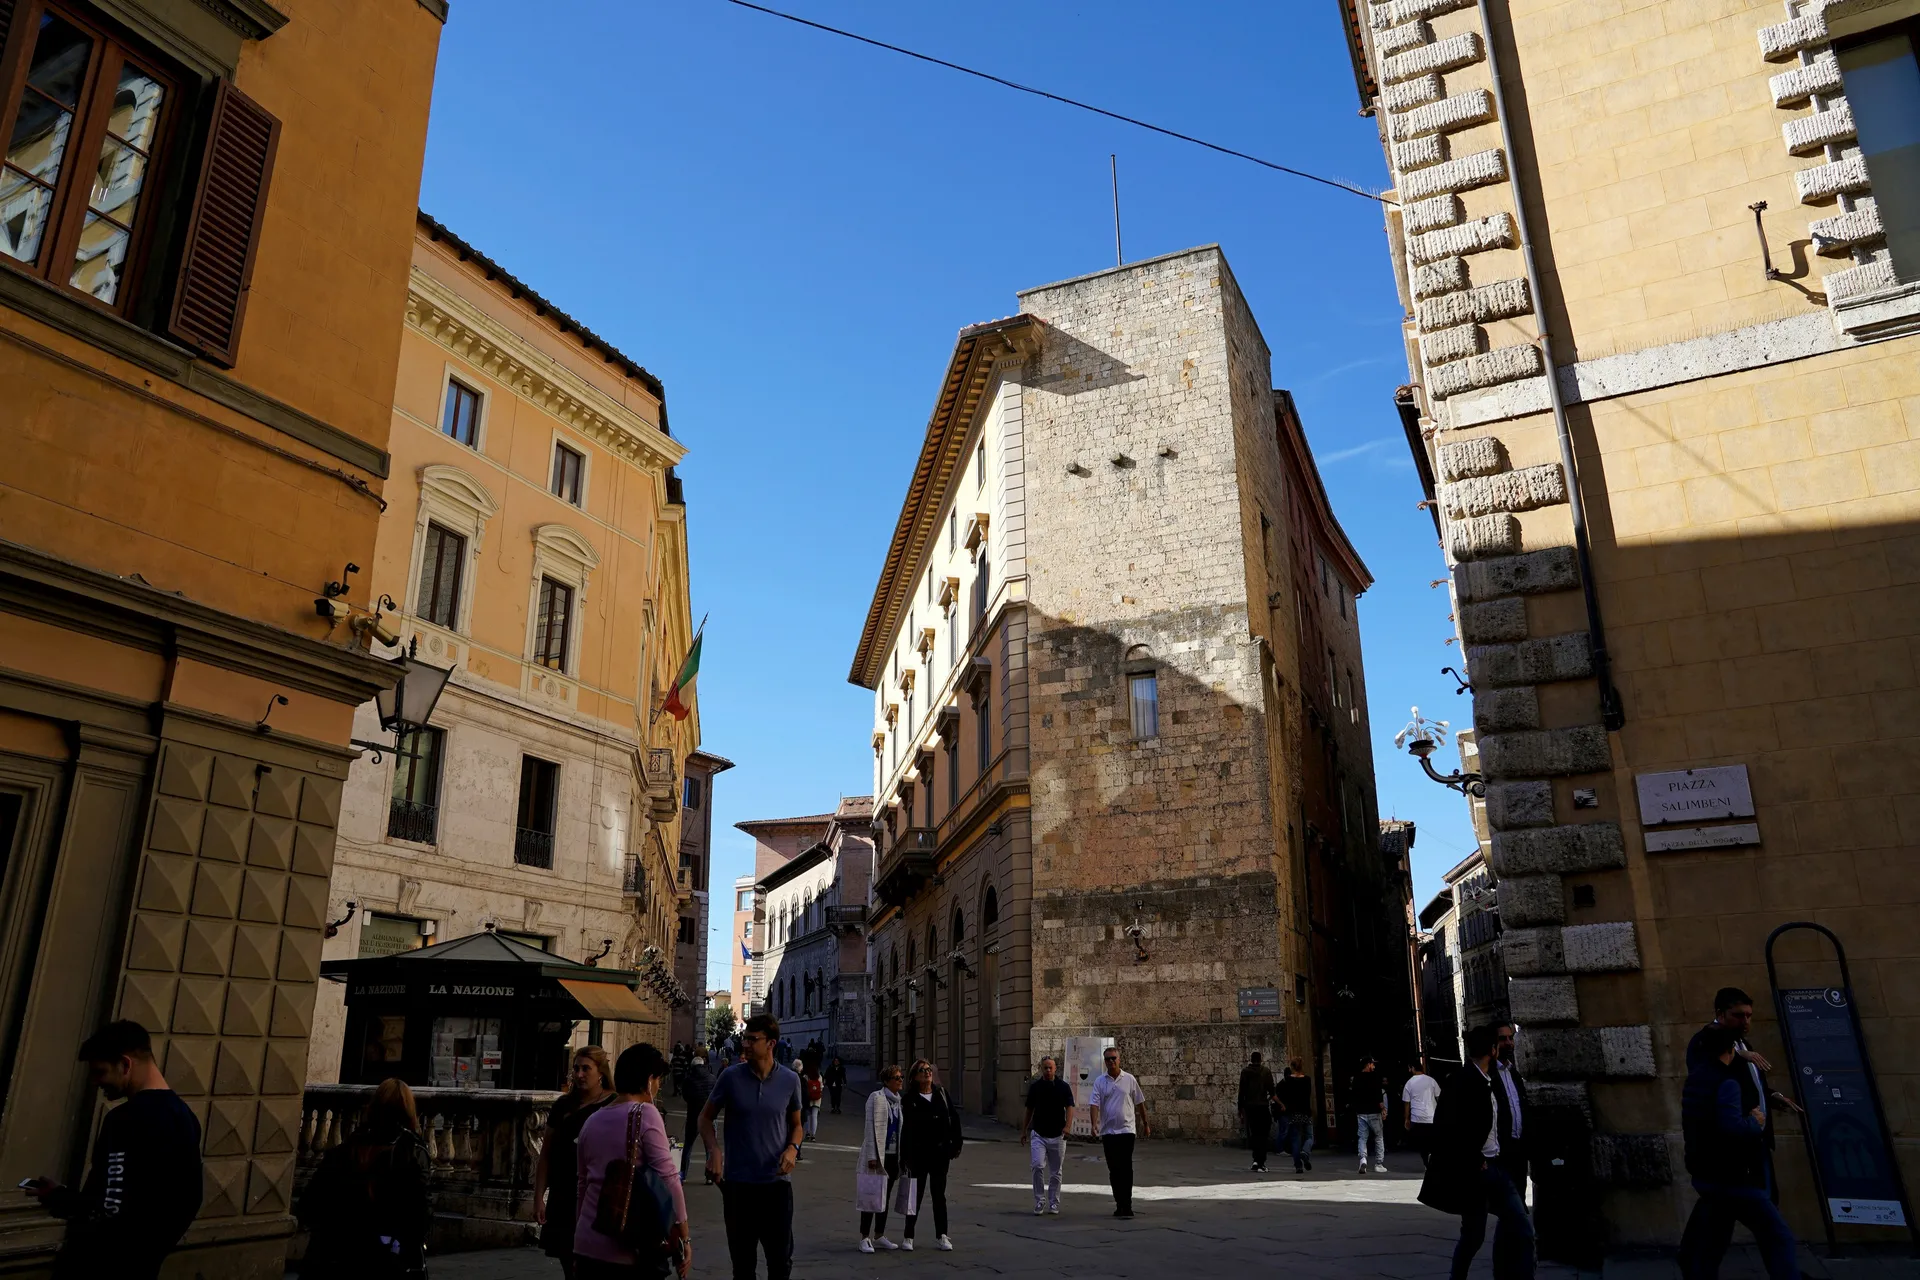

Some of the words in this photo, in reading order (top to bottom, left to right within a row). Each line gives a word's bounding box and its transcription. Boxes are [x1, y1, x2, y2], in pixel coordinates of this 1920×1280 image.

[1668, 779, 1716, 792] PIAZZA
[1661, 797, 1731, 812] SALIMBENI
[354, 986, 365, 995] LA
[368, 984, 406, 995] NAZIONE
[429, 984, 447, 995] LA
[452, 985, 515, 996] NAZIONE
[538, 988, 552, 999] LA
